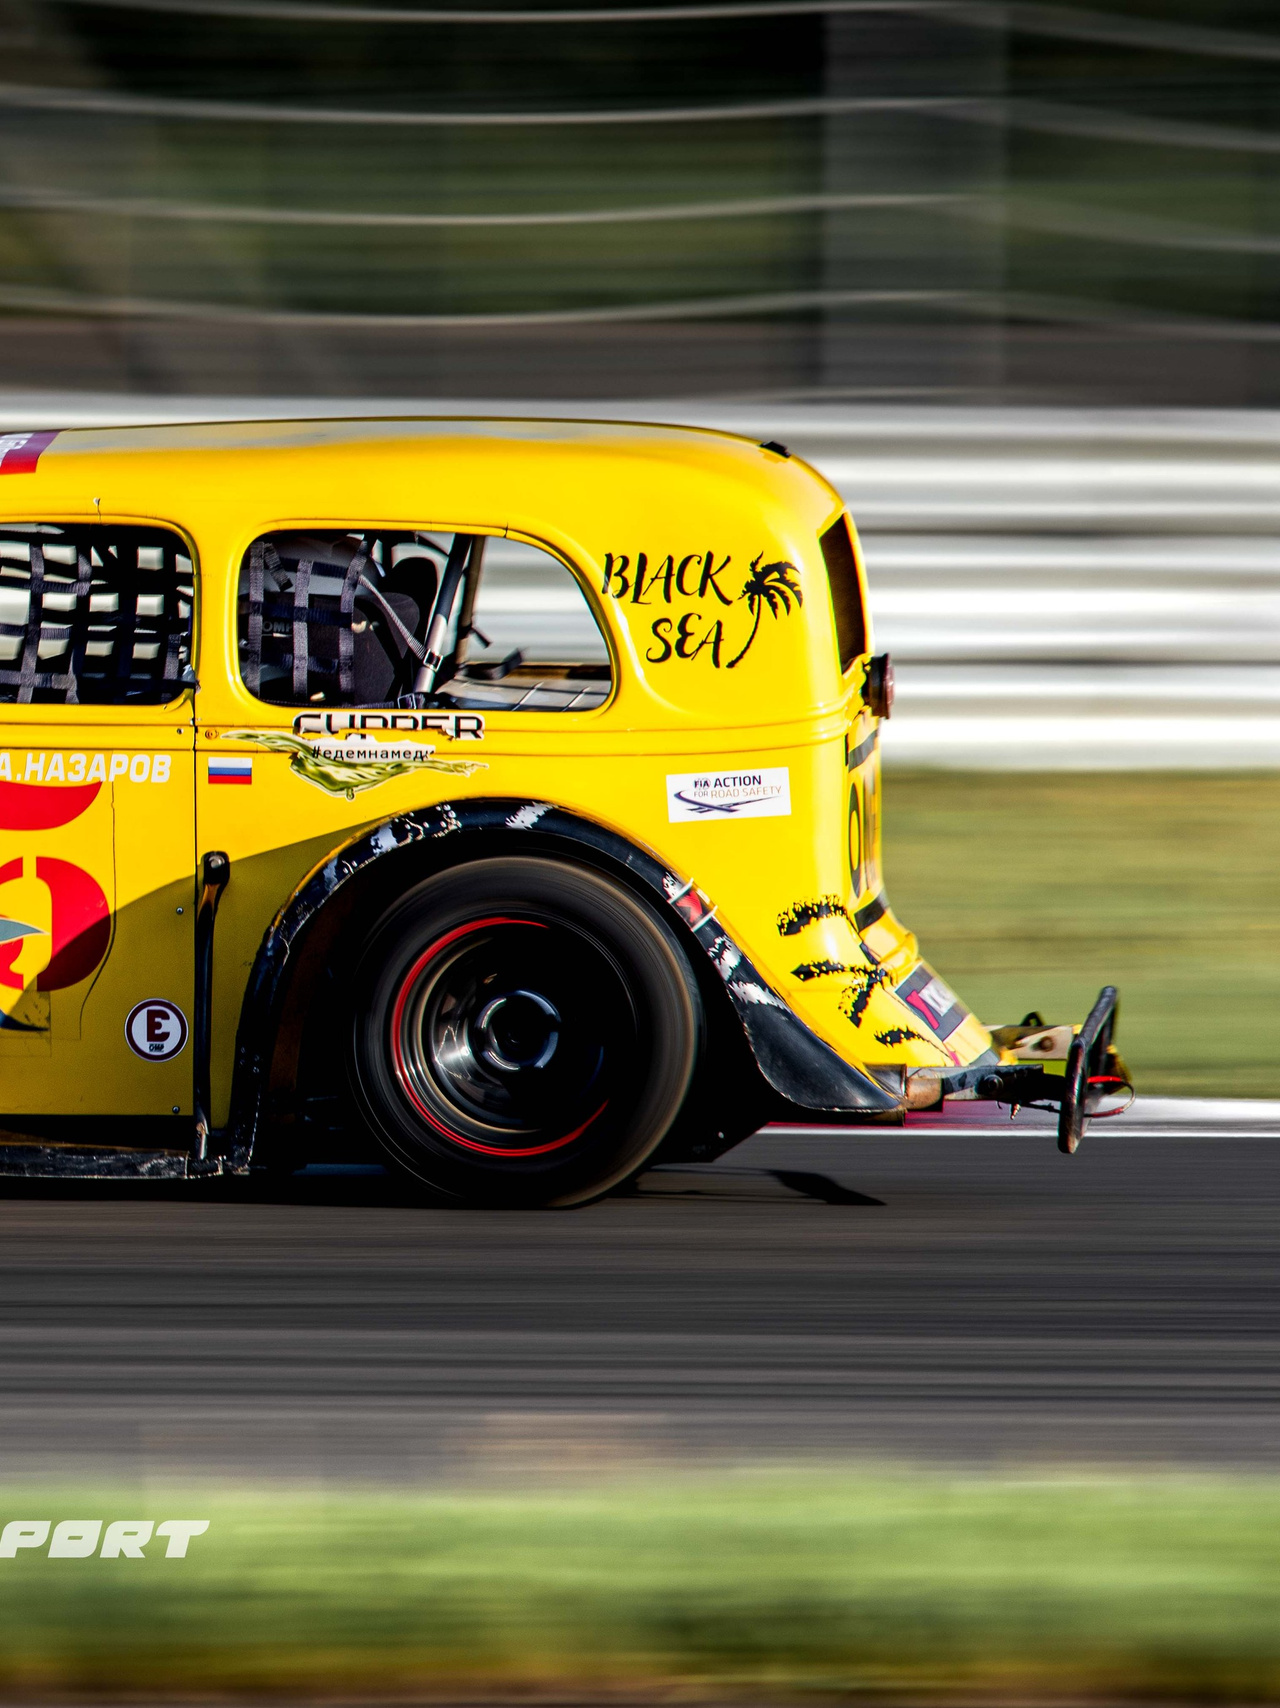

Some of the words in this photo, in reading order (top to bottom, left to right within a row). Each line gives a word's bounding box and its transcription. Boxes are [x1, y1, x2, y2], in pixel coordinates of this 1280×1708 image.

[601, 551, 733, 606] BLACK
[646, 612, 724, 669] SEA
[693, 789, 709, 798] FOR
[711, 788, 740, 798] ROAD
[742, 786, 781, 796] SAFETY
[714, 775, 762, 787] ACTION
[146, 1009, 171, 1042] E
